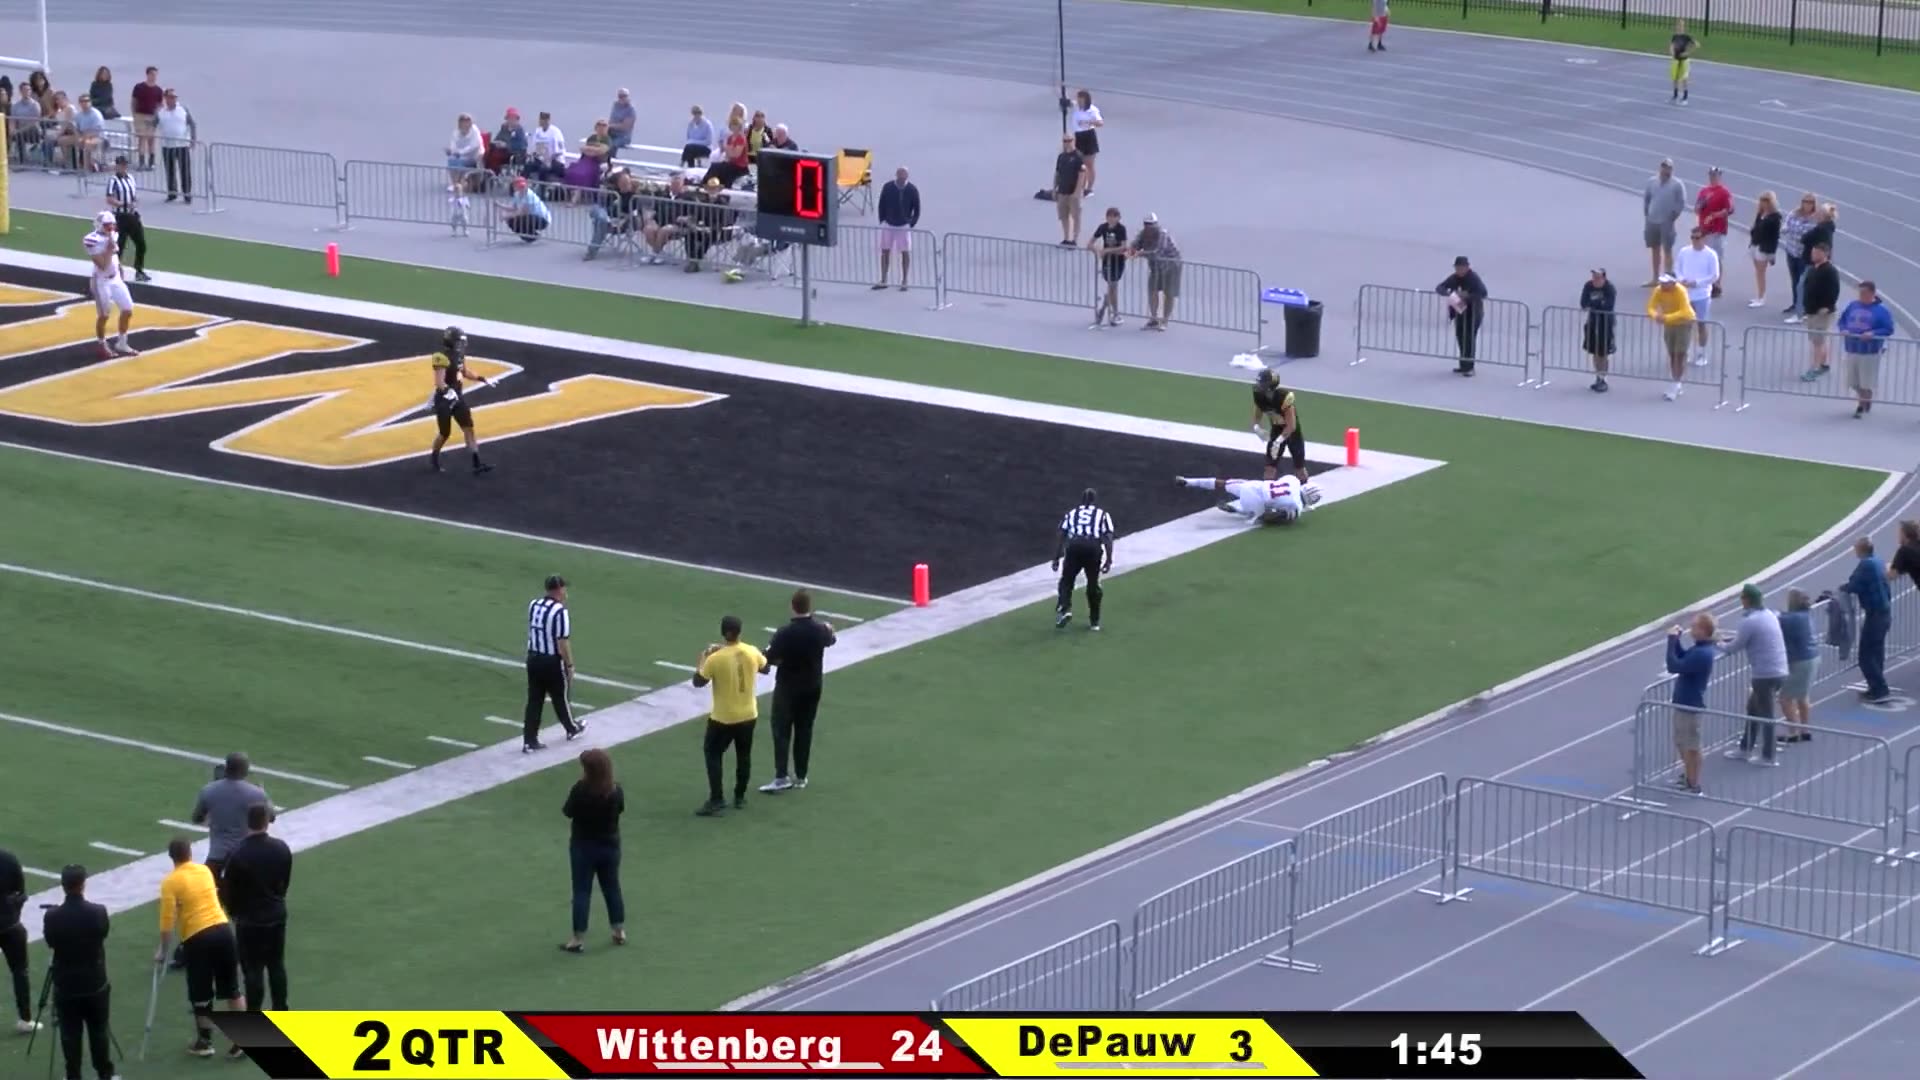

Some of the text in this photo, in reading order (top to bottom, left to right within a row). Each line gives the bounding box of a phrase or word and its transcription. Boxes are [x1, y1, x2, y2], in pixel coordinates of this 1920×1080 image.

[796, 158, 824, 219] 0
[1270, 482, 1292, 499] 11
[1077, 508, 1093, 525] S
[530, 604, 548, 629] H
